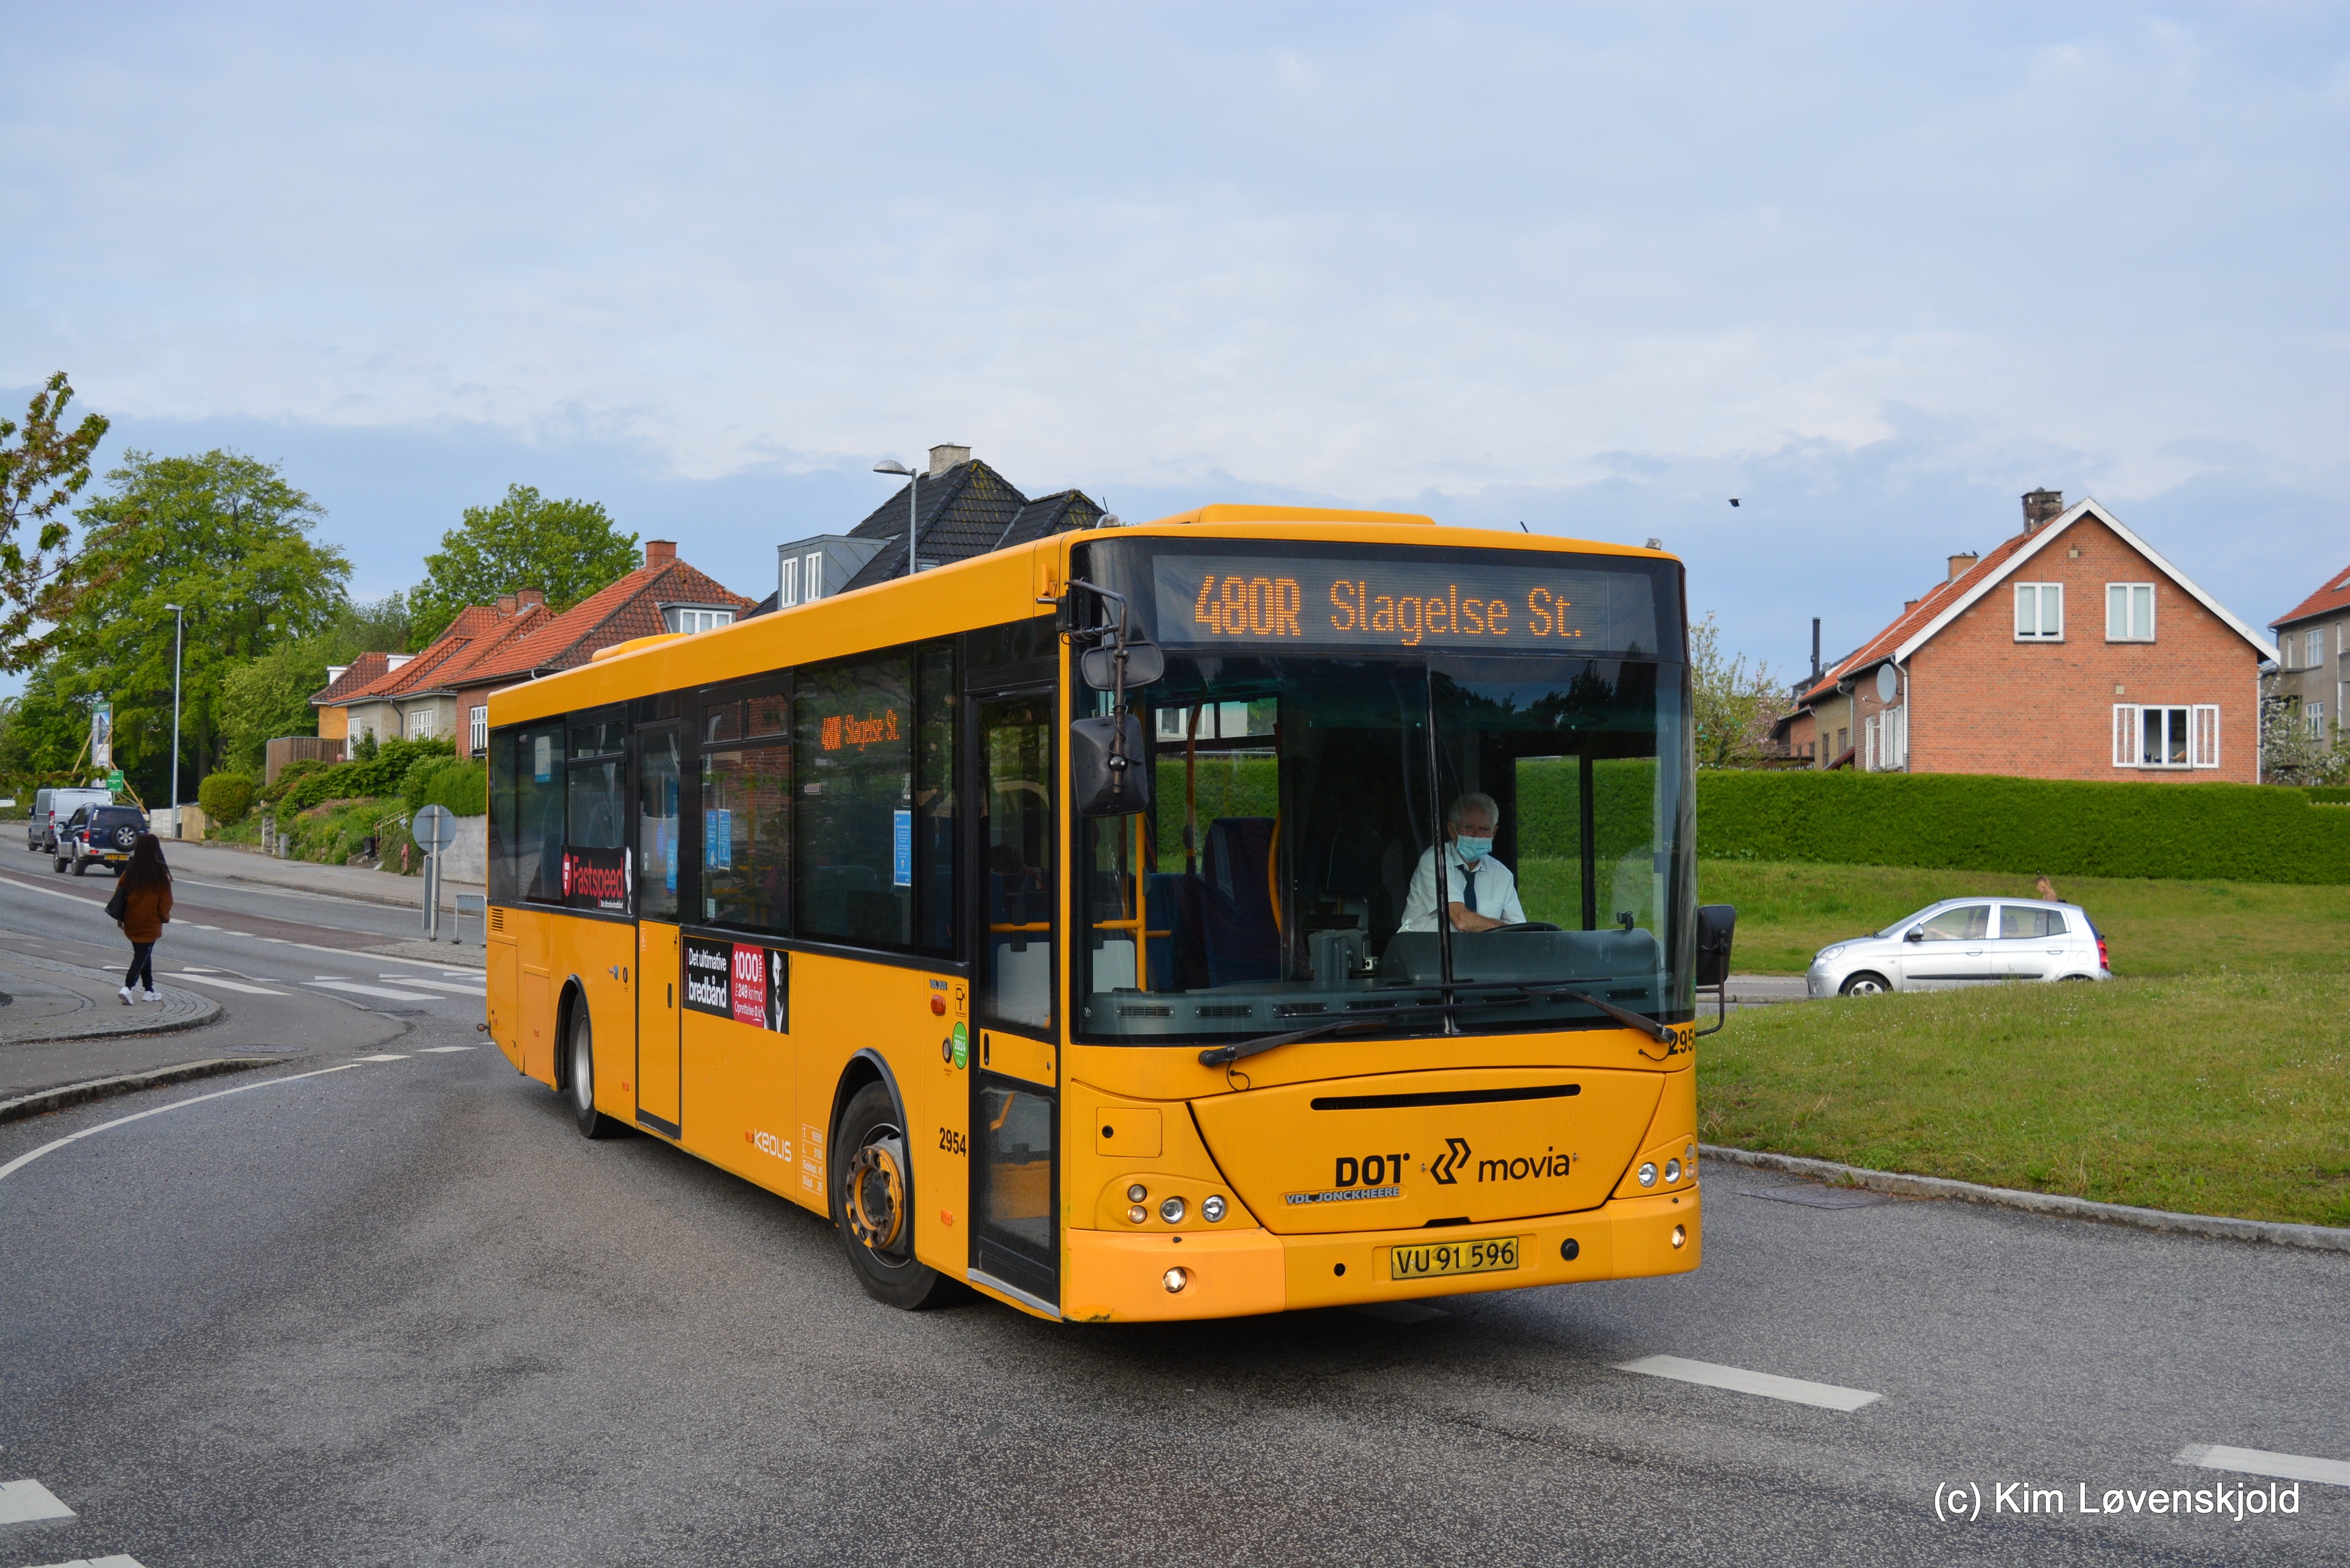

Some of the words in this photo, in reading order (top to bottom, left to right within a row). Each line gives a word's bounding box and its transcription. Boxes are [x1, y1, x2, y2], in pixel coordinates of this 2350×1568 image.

[1195, 575, 1300, 636] 480R
[1330, 580, 1509, 646] Slagelse
[1528, 588, 1581, 637] St.
[846, 712, 884, 751] Slagelse
[573, 856, 624, 908] Fastspeed
[688, 947, 699, 966] Det
[699, 949, 727, 972] ultimative
[734, 950, 759, 983] 1000
[688, 973, 727, 1009] bredbånd
[738, 982, 748, 999] 249
[748, 986, 763, 1002] kr/md
[734, 1001, 754, 1017] Oprettelse
[754, 1006, 758, 1017] 0
[954, 1039, 966, 1053] 2014
[1667, 1028, 1695, 1056] 295
[939, 1127, 966, 1157] 2954
[1335, 1152, 1410, 1188] DOT
[1478, 1146, 1570, 1183] movia
[1285, 1193, 1313, 1204] VDL
[1315, 1186, 1400, 1203] JONCKHEERE
[1397, 1249, 1431, 1274] VU
[1436, 1247, 1461, 1271] 91
[1471, 1241, 1515, 1267] 596
